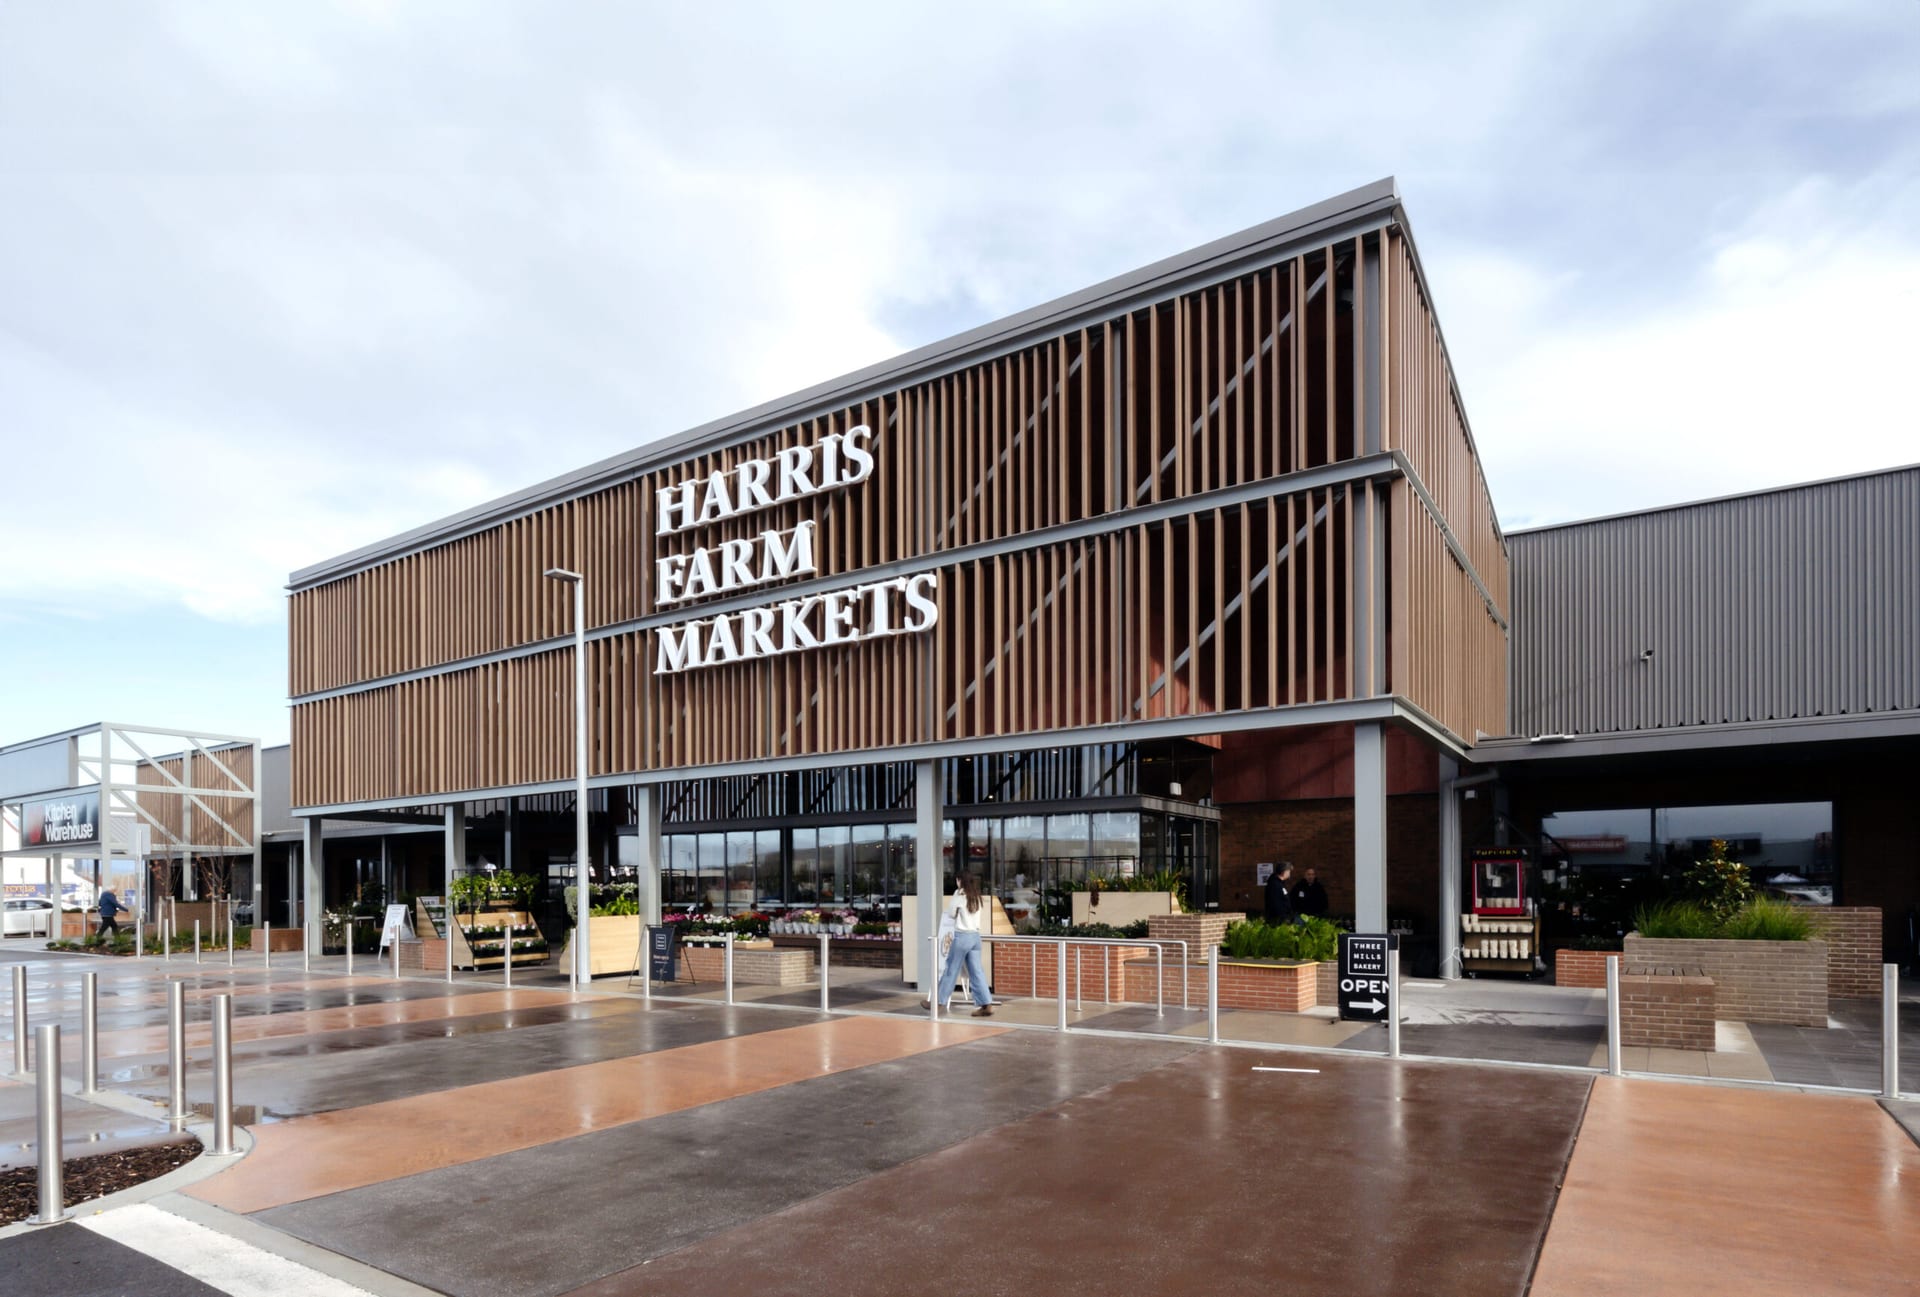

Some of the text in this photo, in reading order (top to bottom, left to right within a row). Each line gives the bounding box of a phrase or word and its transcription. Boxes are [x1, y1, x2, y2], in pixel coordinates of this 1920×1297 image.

[656, 425, 874, 536] HARRIS
[656, 519, 816, 606] FARM
[653, 574, 938, 675] MARKETS
[45, 802, 77, 821] Kitchen
[45, 822, 93, 842] Warehouse
[1341, 979, 1389, 993] OPEN
